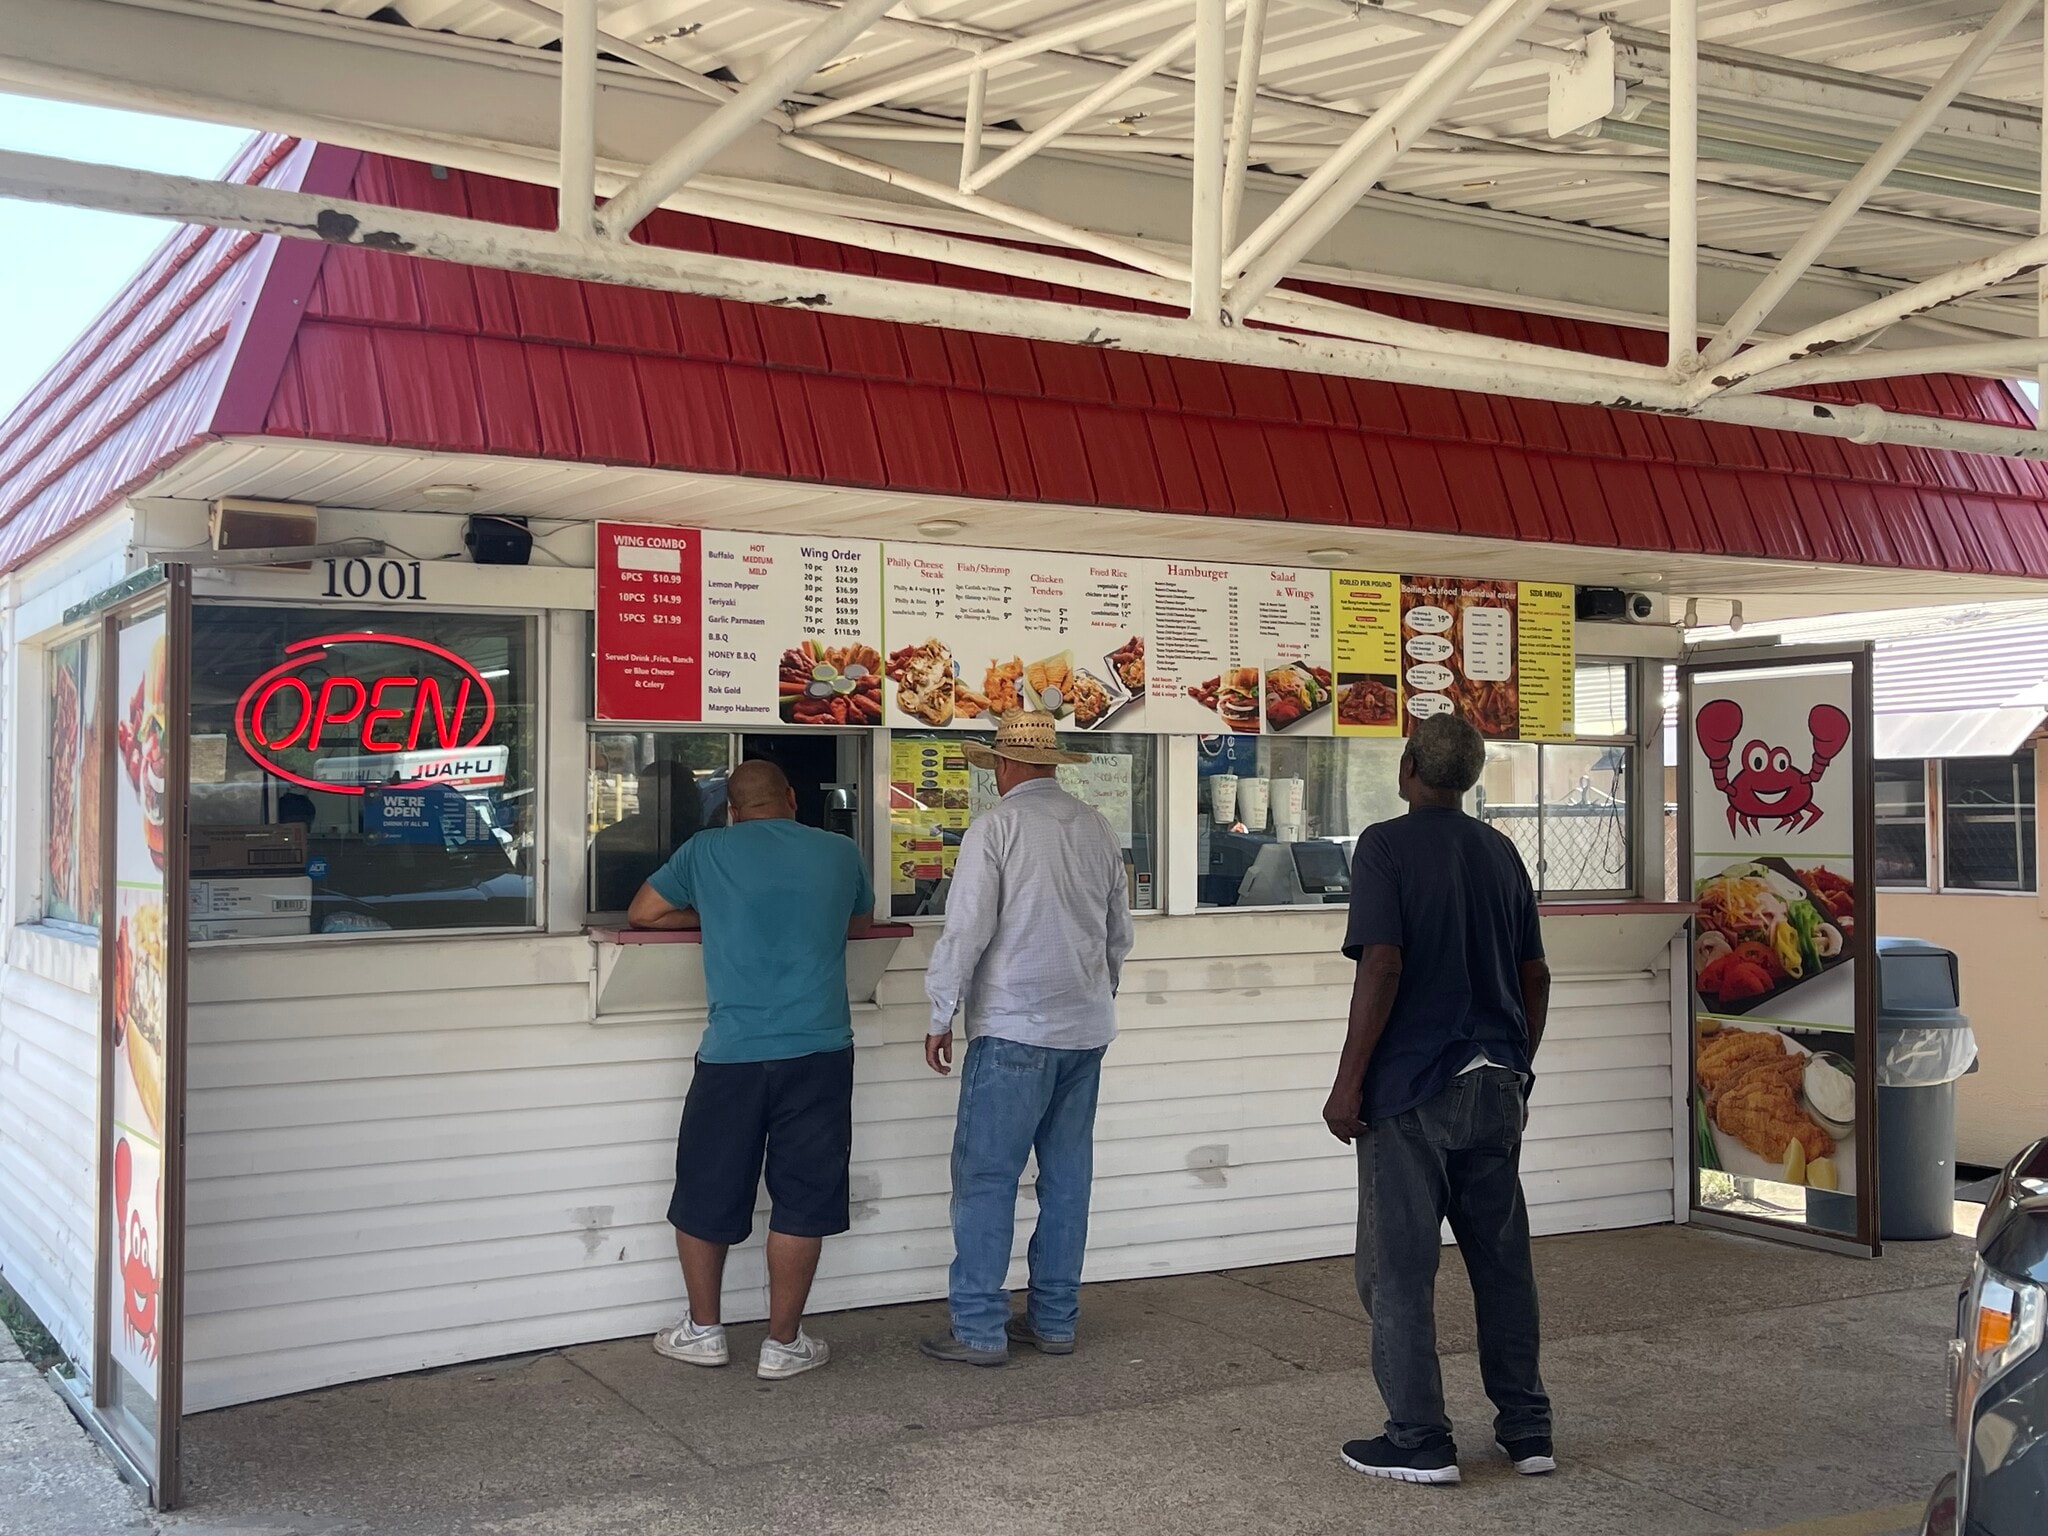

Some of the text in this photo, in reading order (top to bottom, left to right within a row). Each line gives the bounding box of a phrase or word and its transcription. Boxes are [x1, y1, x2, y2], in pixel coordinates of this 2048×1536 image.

[613, 535, 686, 549] WING COMBO
[709, 551, 734, 559] Buffalo
[800, 547, 861, 561] Wing Order
[743, 556, 773, 564] MEDIUM
[887, 557, 944, 569] Philly Cheese
[920, 570, 944, 578] Steak
[957, 563, 1011, 576] Fish/Shrimp
[1090, 567, 1127, 577] Fried Rice
[1168, 564, 1228, 581] Hamburger
[322, 559, 426, 599] 1001
[621, 572, 682, 584] 6PCS $10.99
[1030, 574, 1063, 583] Chicken
[1270, 571, 1296, 582] Salad
[735, 582, 759, 591] Pepper
[1030, 586, 1063, 596] Tenders
[1401, 585, 1427, 596] Boiling
[1428, 586, 1458, 598] Seafood
[1461, 589, 1496, 598] Individual
[619, 593, 682, 604] 10PCS $14.99
[1285, 587, 1314, 601] Wings
[708, 598, 736, 607] Teriyaki
[619, 613, 682, 624] 15PCS $21.99
[708, 615, 729, 623] Garlic
[708, 633, 728, 642] B.B.Q
[605, 653, 629, 661] Served
[631, 654, 649, 662] Drink
[708, 651, 756, 661] HONEY B.B.Q
[650, 668, 675, 676] Cheese
[708, 668, 731, 678] Crispy
[642, 681, 664, 690] Celery
[708, 704, 734, 713] Mango
[251, 676, 471, 752] OPEN
[383, 796, 425, 807] WE'RE
[383, 807, 421, 817] OPEN
